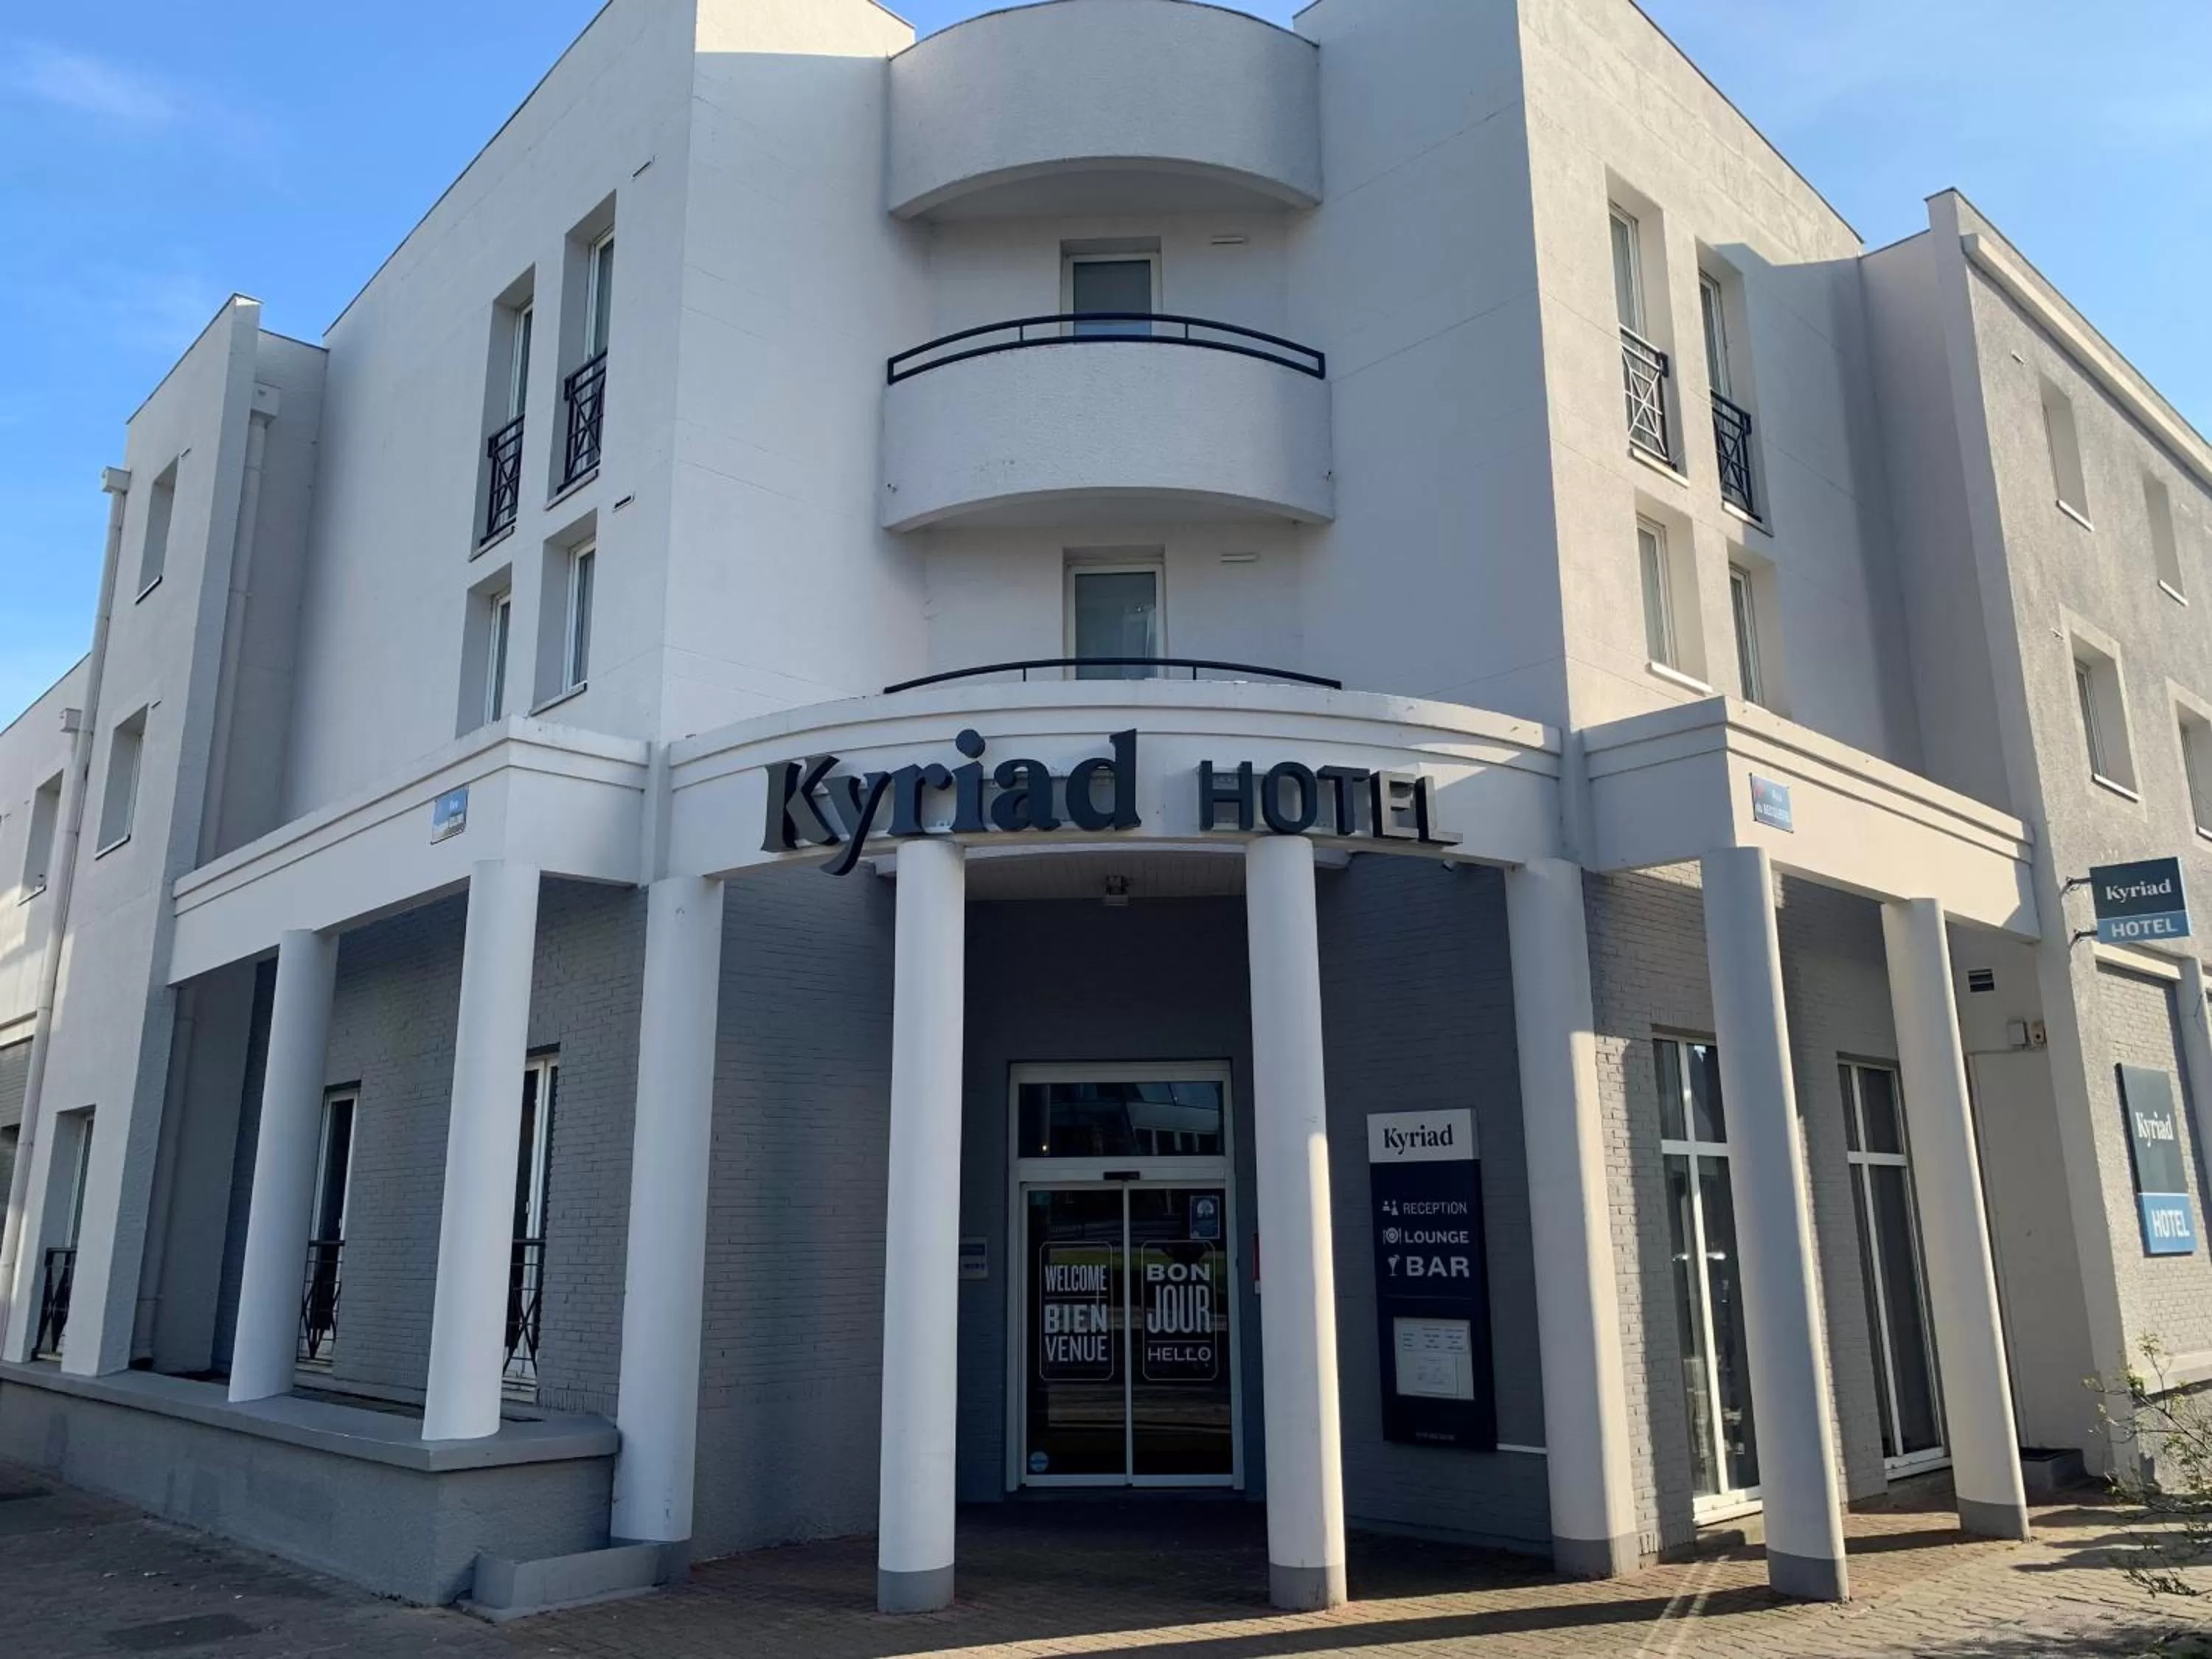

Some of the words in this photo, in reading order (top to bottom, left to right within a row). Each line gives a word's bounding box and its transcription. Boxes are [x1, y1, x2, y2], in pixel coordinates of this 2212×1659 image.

[760, 728, 1141, 876] Kyriad
[1198, 759, 1463, 846] HOTEL
[2105, 879, 2171, 902] Kyriad
[2111, 917, 2179, 937] HOTEL
[1383, 1124, 1454, 1155] Kyriad
[2135, 1111, 2174, 1147] Kyriad
[1403, 1201, 1468, 1214] RECEPTION
[2151, 1209, 2191, 1237] HOTEL
[1405, 1231, 1470, 1244] LOUNGE
[1044, 1265, 1107, 1292] WELCOME
[1147, 1263, 1211, 1281] BON
[1406, 1256, 1470, 1278] BAR
[1044, 1304, 1107, 1334] BIEN
[1147, 1284, 1211, 1333] JOUR
[1044, 1335, 1109, 1362] VENUE
[1147, 1346, 1212, 1362] HELLO
